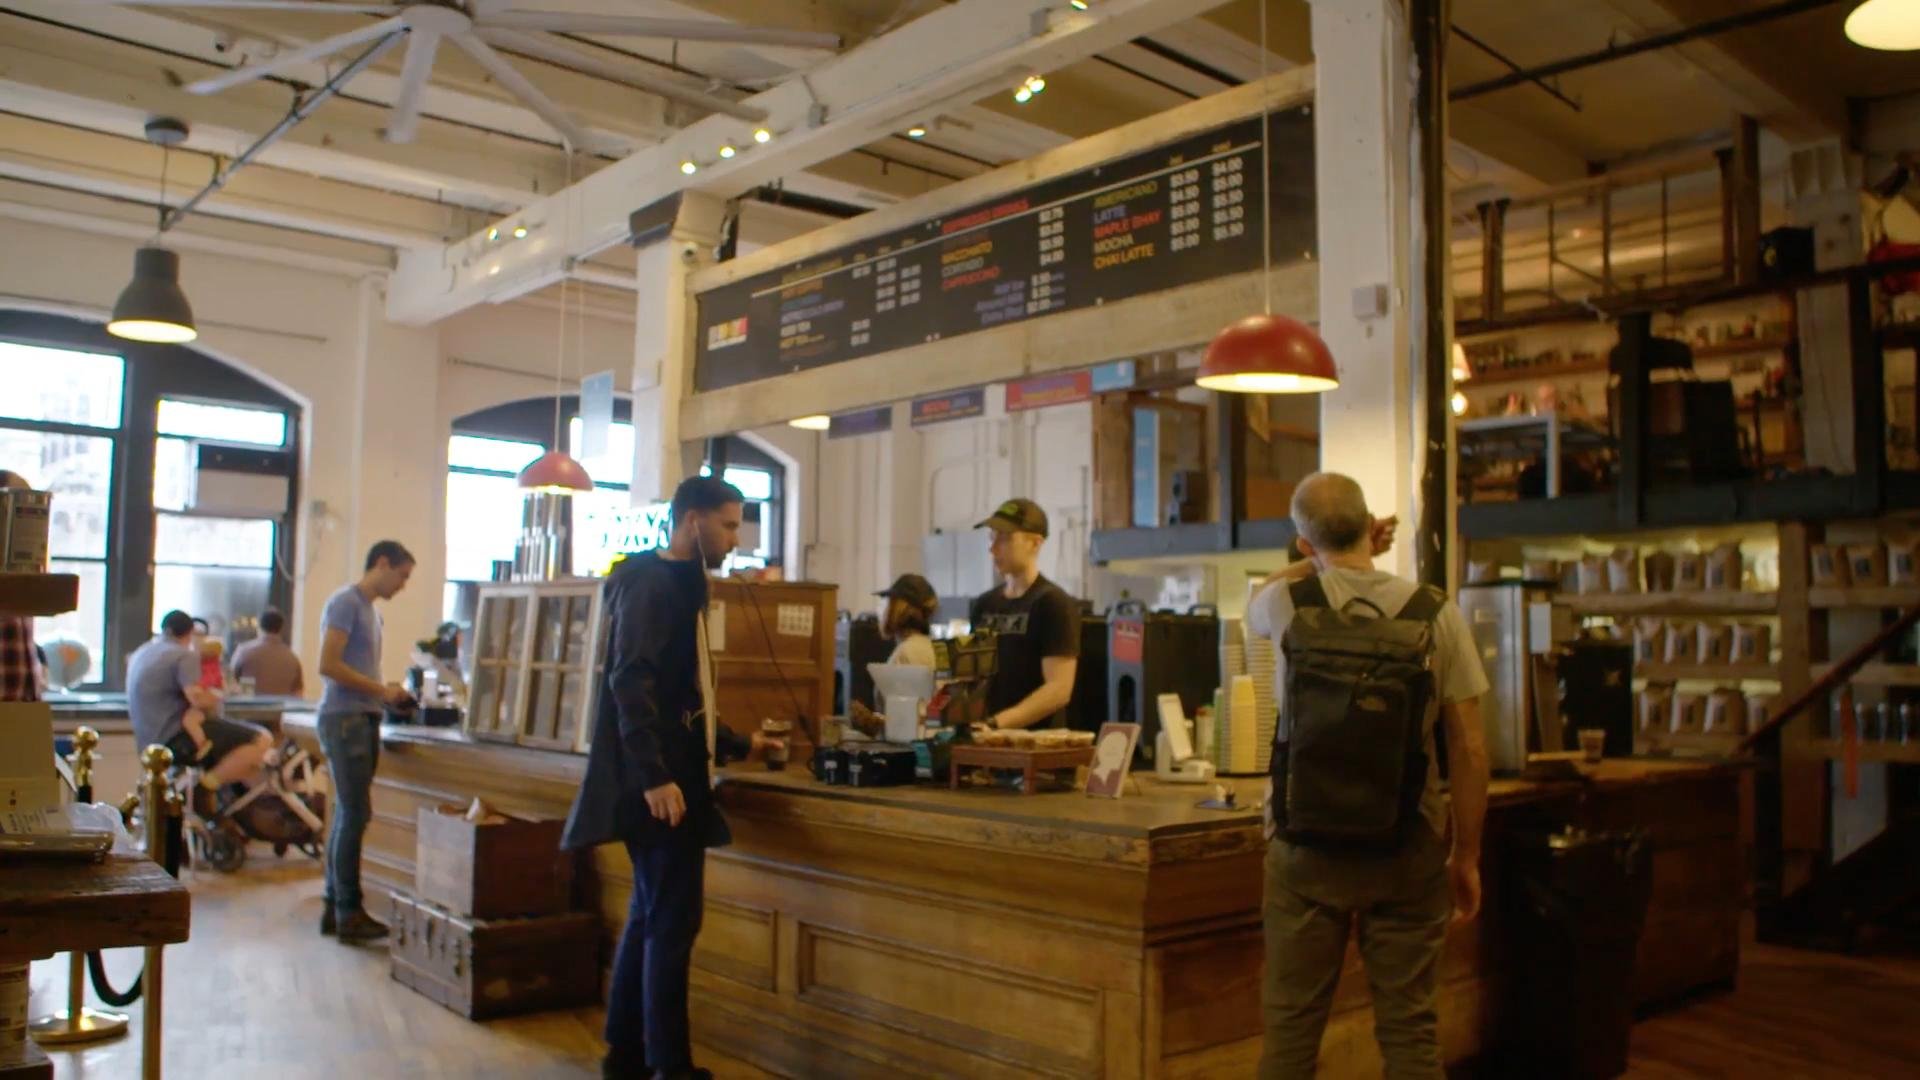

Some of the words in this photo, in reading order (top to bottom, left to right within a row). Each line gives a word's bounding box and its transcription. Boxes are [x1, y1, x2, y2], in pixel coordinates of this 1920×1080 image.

[1094, 204, 1126, 224] LATTE
[1094, 233, 1134, 254] MOCHA
[1121, 243, 1156, 264] LATTE
